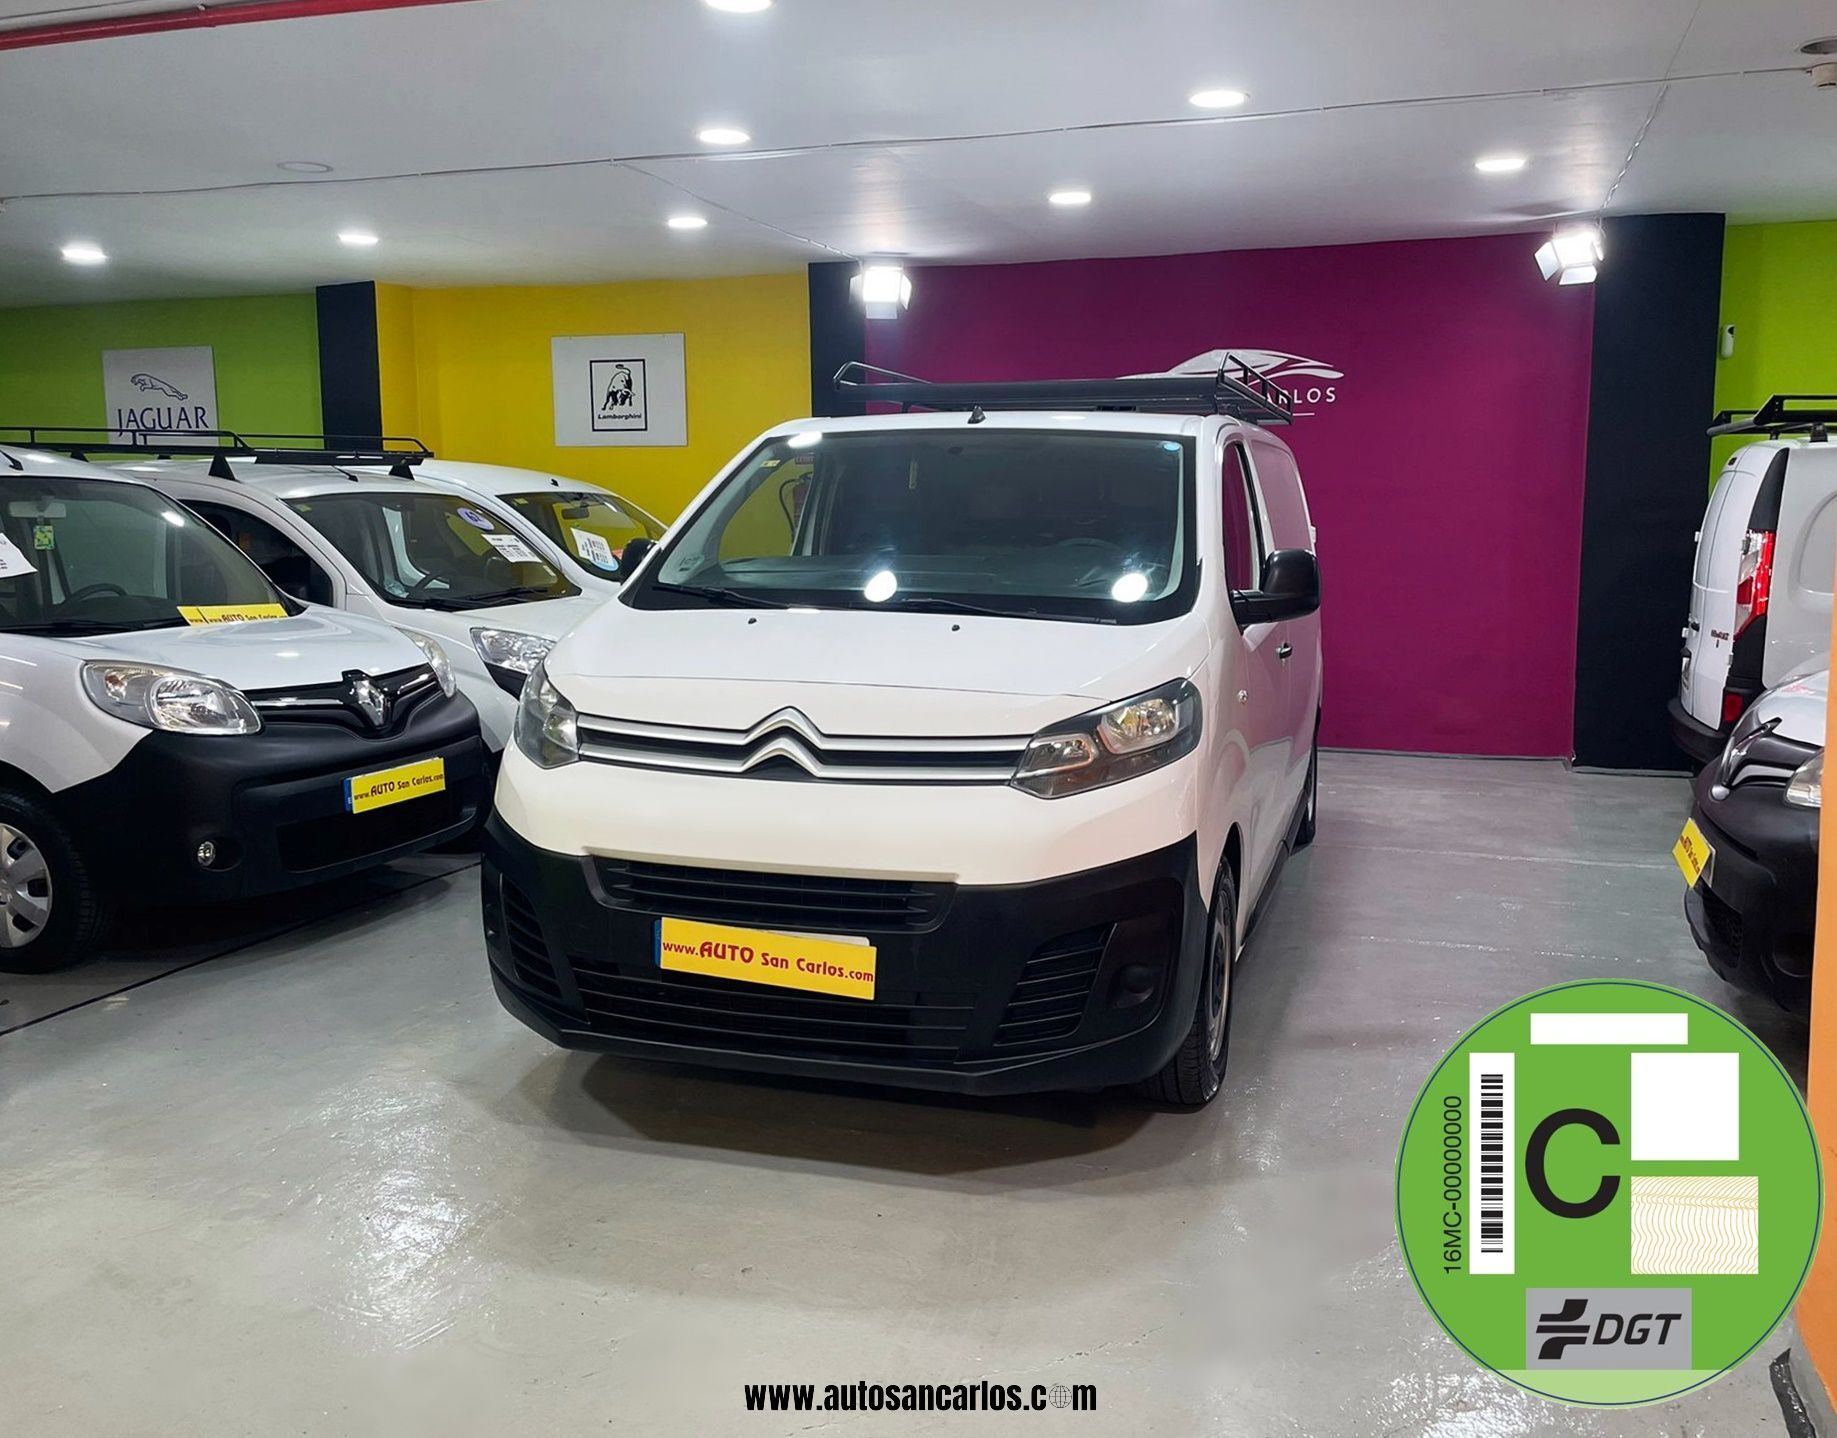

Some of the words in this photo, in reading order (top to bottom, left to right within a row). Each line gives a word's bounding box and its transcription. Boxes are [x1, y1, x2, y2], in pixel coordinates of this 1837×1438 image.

[117, 406, 209, 437] JAGUAR
[354, 780, 395, 800] www.AUTO
[397, 780, 411, 790] San
[662, 941, 754, 964] www.AUTO
[761, 952, 789, 969] San
[796, 958, 874, 983] Carlos.com
